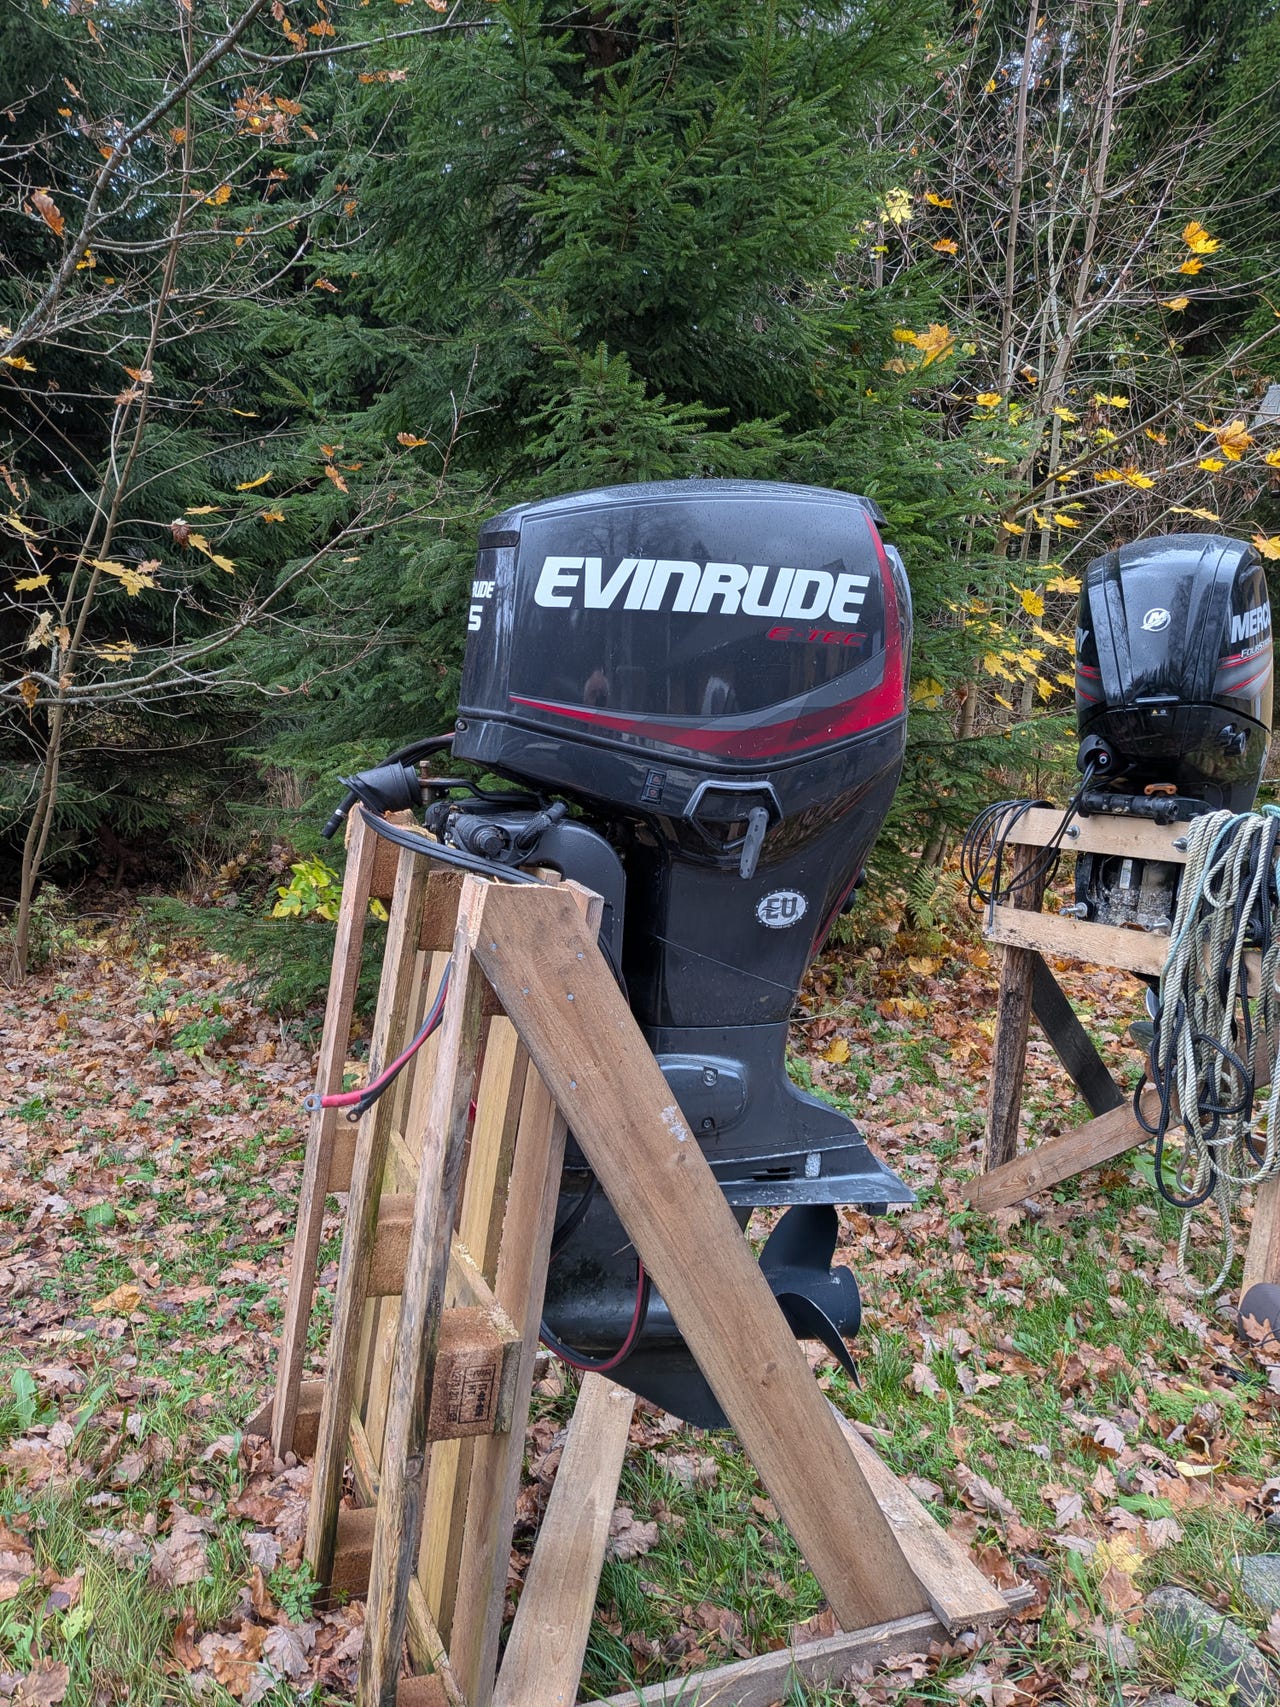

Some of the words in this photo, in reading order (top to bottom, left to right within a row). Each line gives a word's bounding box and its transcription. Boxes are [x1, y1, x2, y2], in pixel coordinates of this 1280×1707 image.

[534, 556, 870, 624] EVINRUDE
[768, 627, 867, 647] E-TEC
[764, 897, 797, 920] EU
